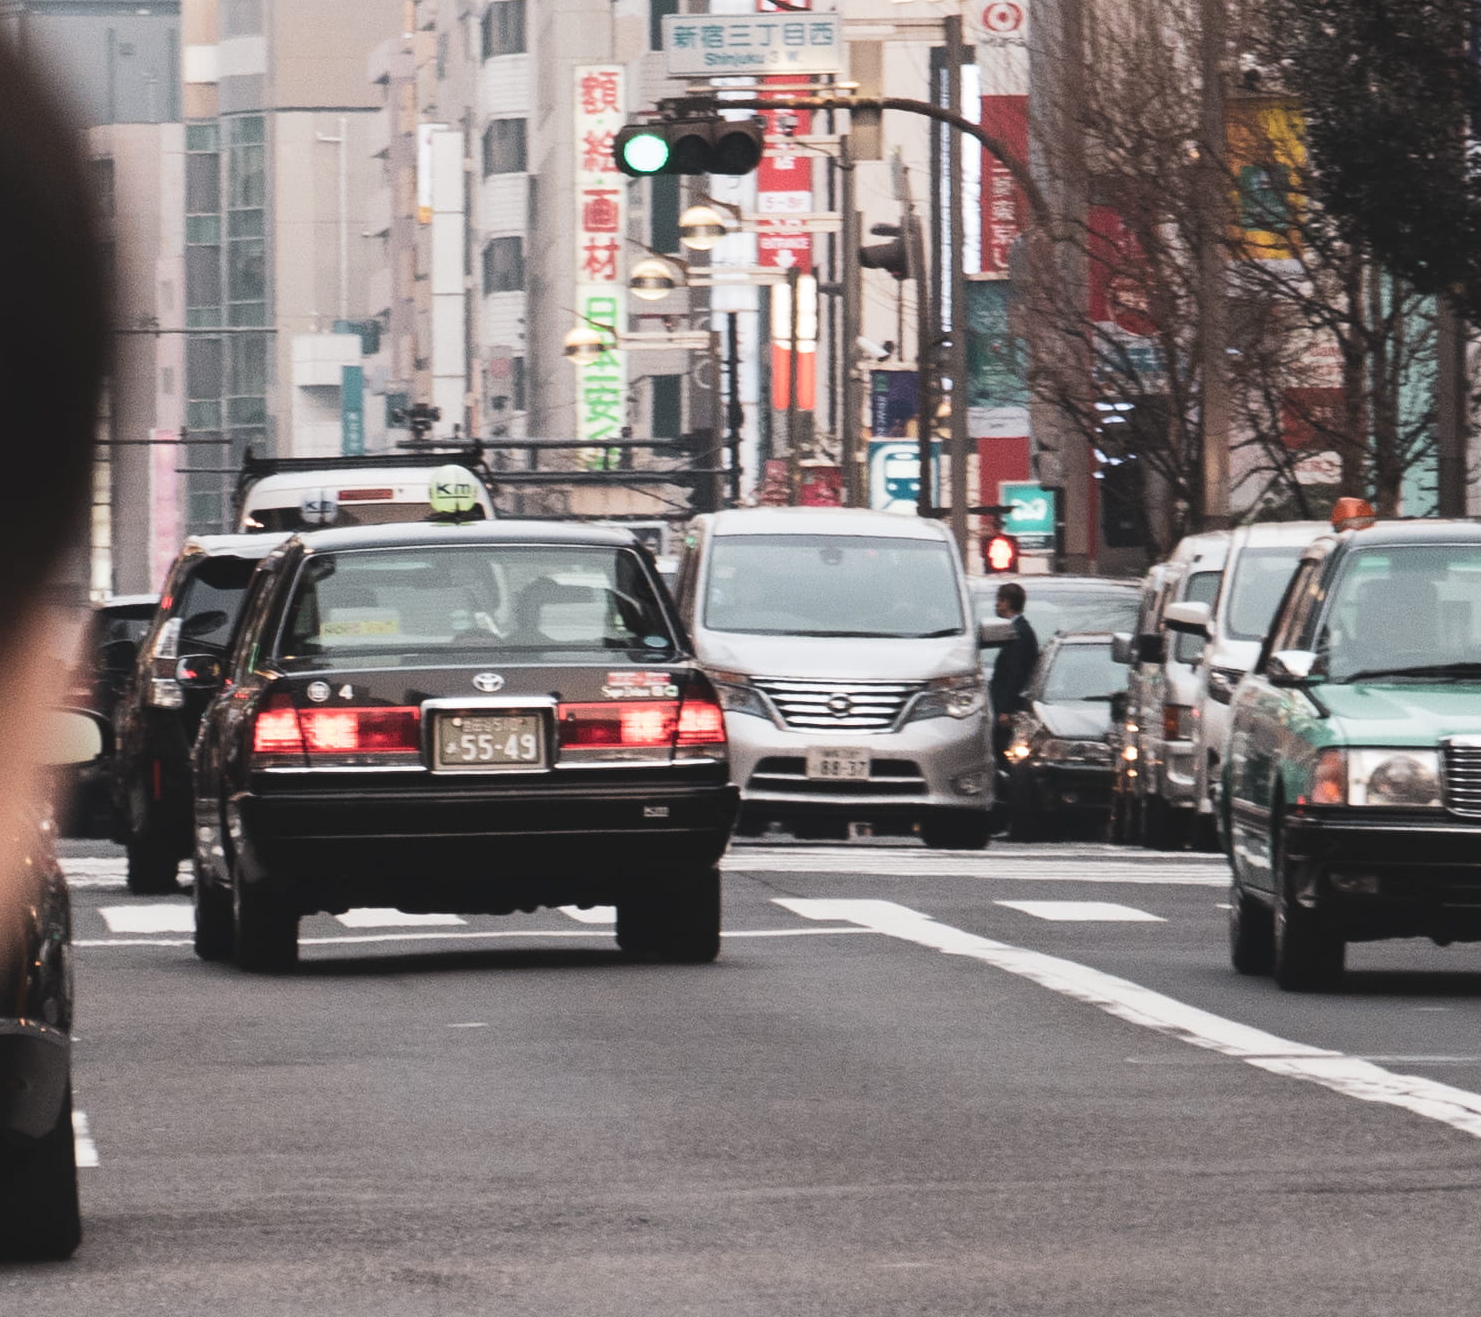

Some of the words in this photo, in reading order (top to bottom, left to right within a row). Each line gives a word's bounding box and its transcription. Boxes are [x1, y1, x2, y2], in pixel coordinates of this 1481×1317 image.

[673, 22, 835, 49] 新宿三丁目西
[704, 51, 765, 68] Shinjuku
[338, 683, 354, 700] 4
[461, 733, 537, 761] 55-49
